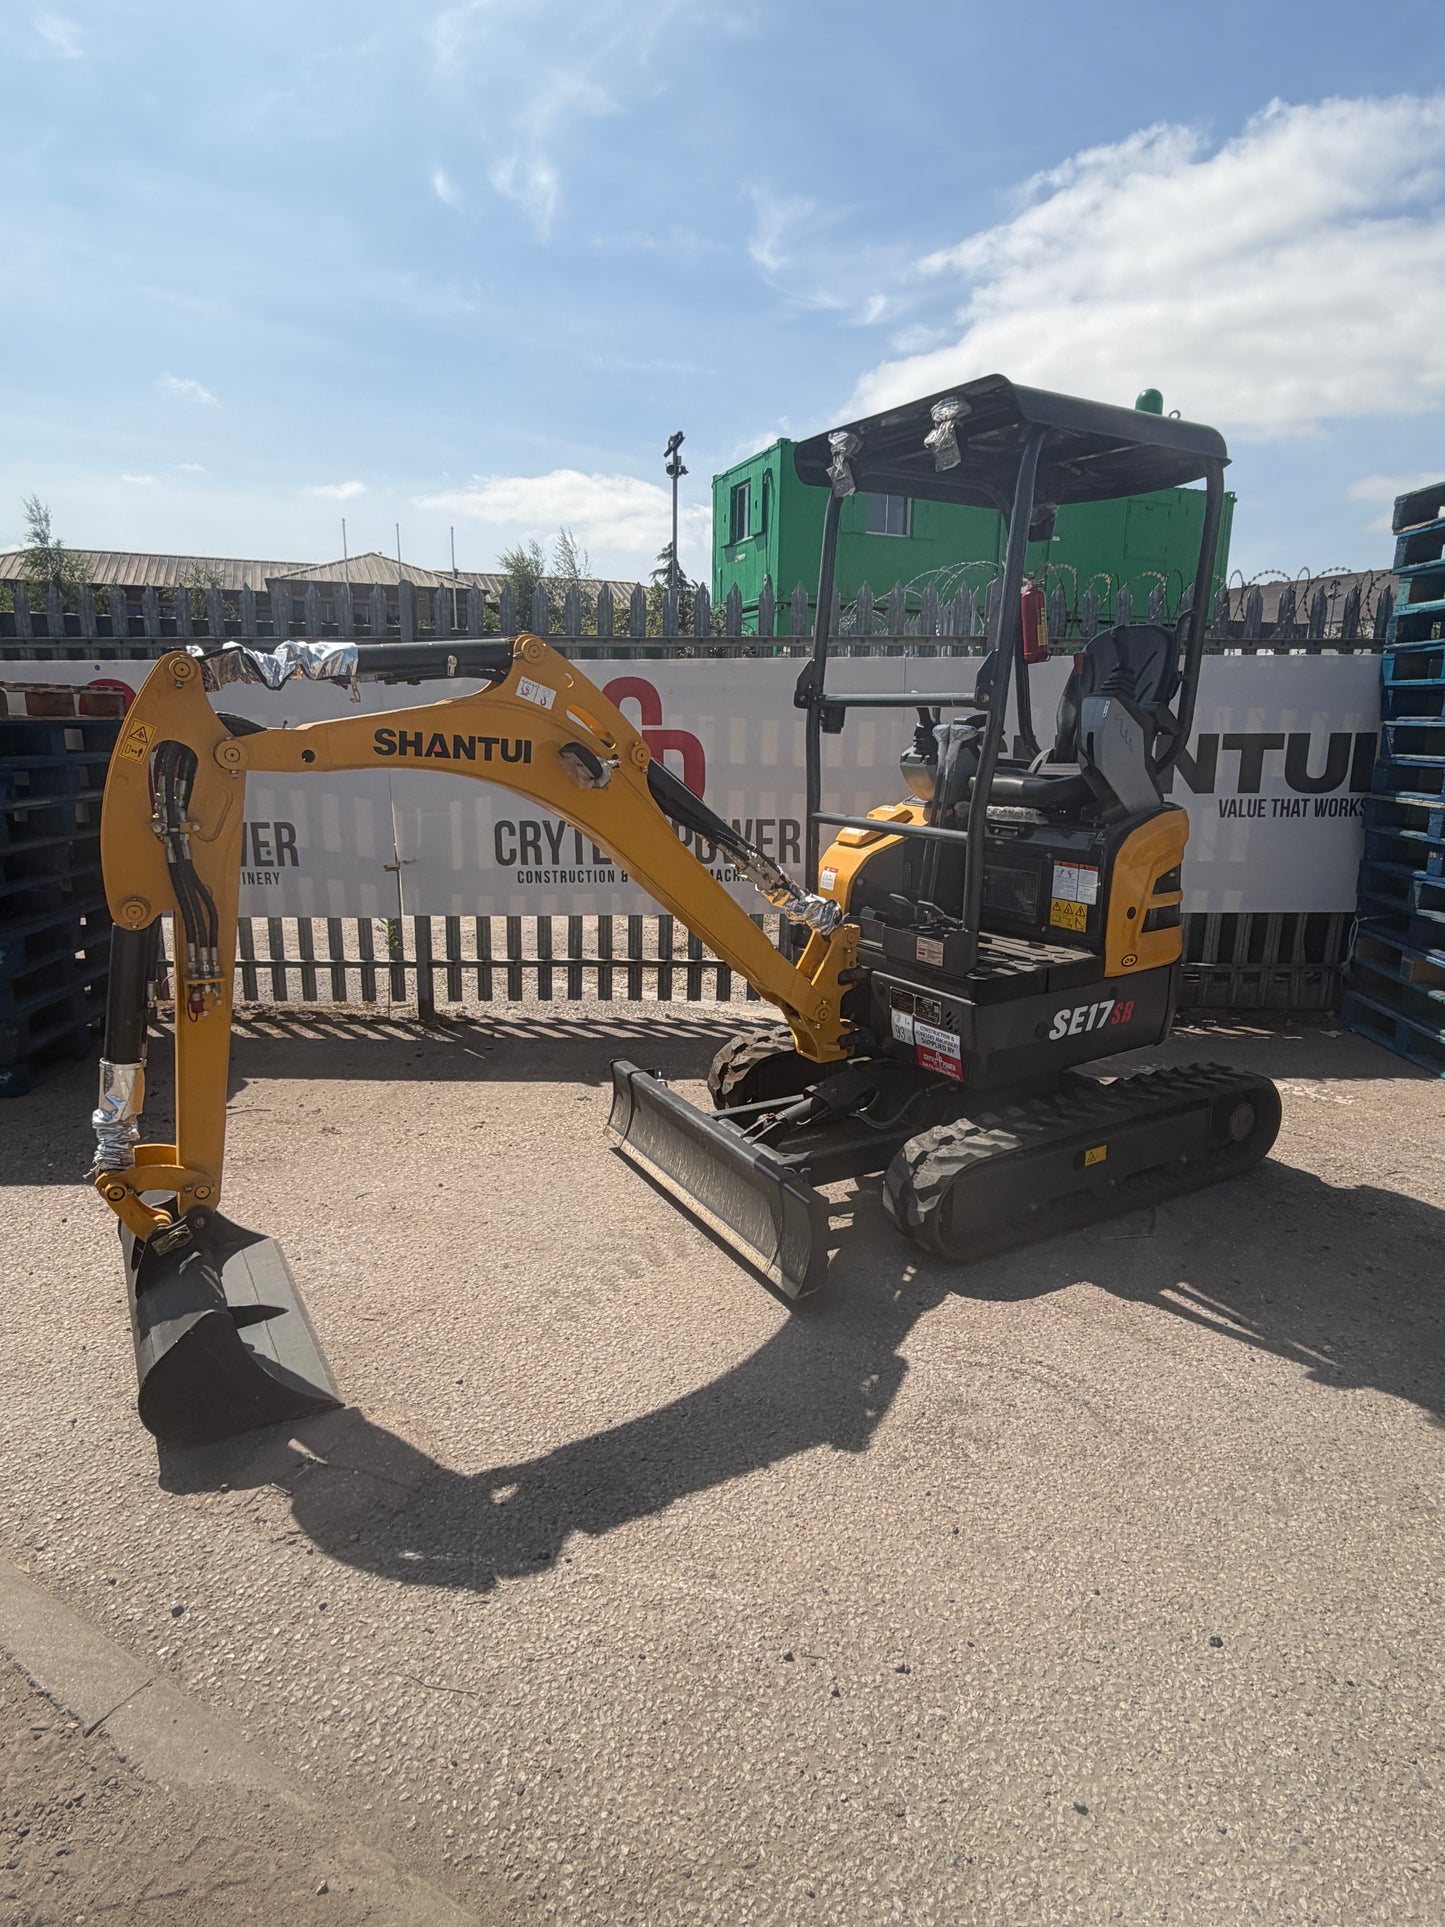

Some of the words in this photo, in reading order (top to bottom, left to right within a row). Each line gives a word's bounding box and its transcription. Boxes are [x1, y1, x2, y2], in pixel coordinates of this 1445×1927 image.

[373, 728, 532, 764] SHANTUI
[1163, 732, 1378, 794] NTUI
[1219, 799, 1266, 818] VALUE
[1272, 798, 1310, 818] THAT
[517, 870, 615, 884] CONSTRUCTION
